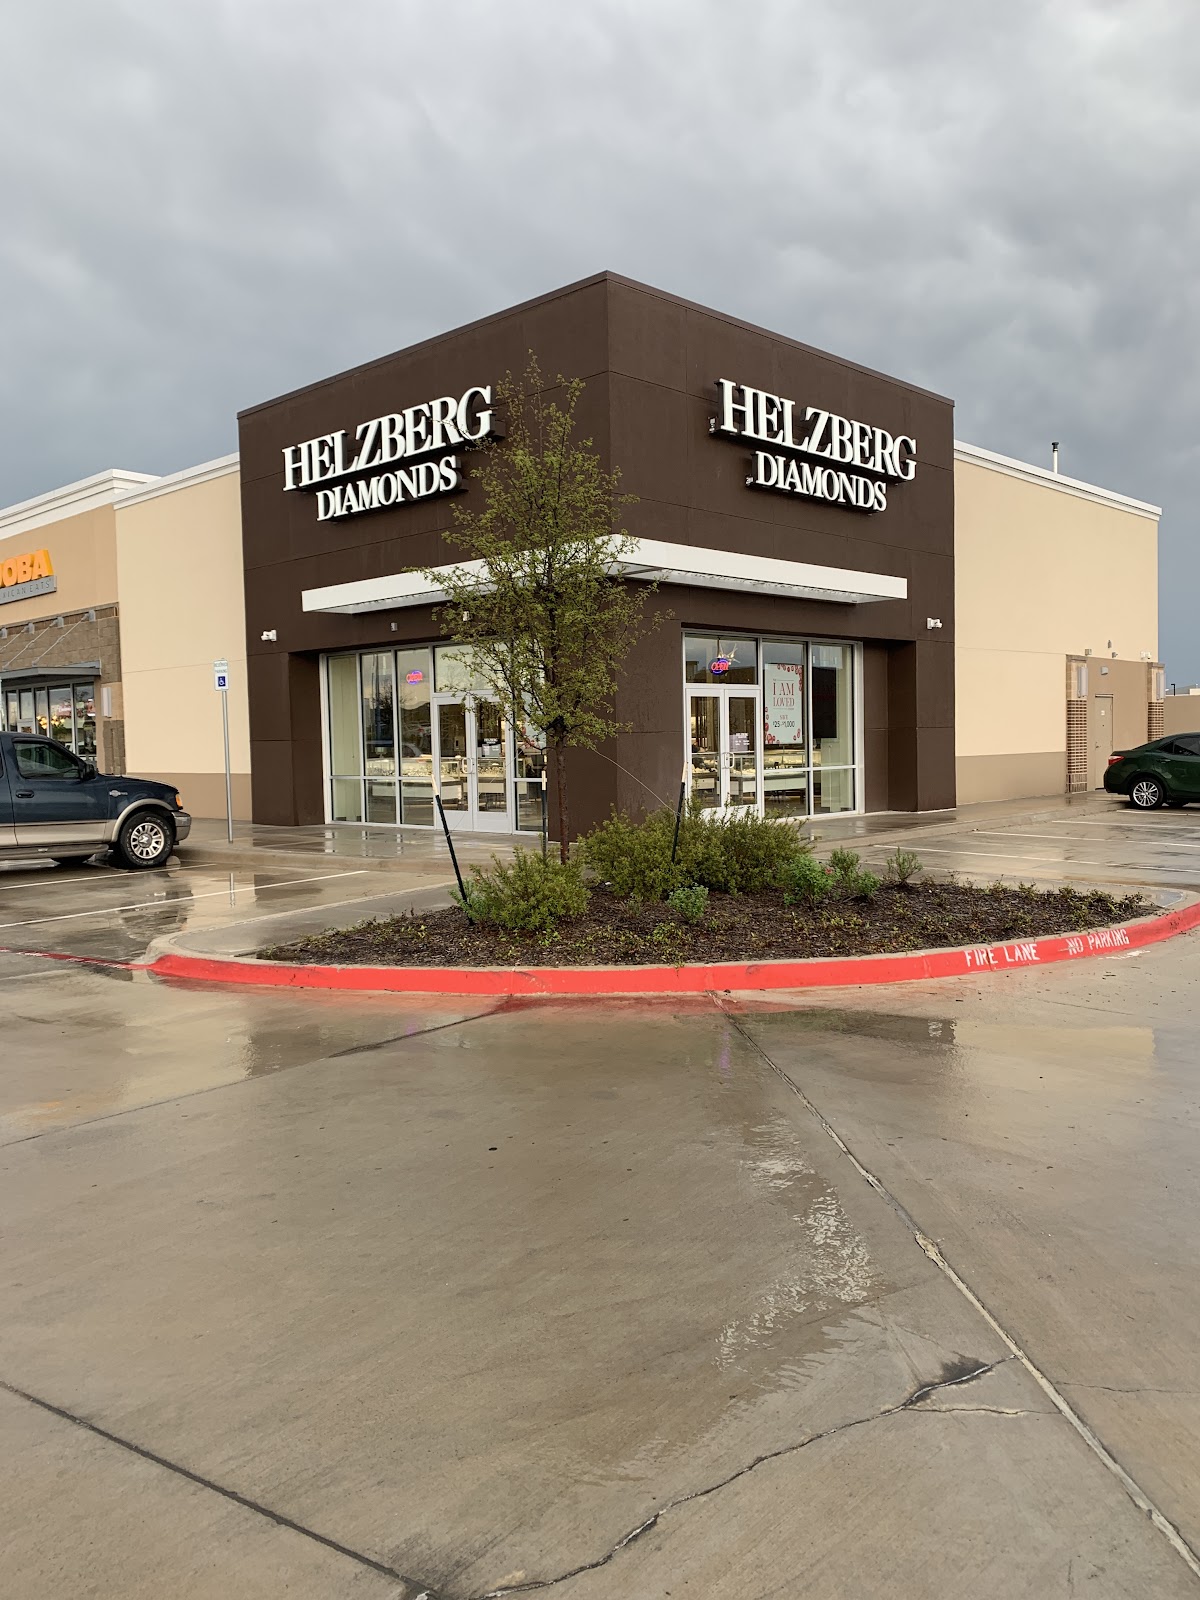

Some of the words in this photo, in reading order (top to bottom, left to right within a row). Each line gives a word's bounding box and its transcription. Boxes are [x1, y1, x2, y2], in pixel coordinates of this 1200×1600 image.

[282, 385, 493, 491] HELZBERG
[718, 378, 917, 480] HELZBERG
[316, 455, 460, 521] DIAMONDS
[755, 450, 887, 512] DIAMONDS
[0, 549, 53, 588] OBA
[779, 682, 795, 695] AM
[964, 948, 999, 967] FIRE
[1003, 943, 1041, 962] LANE
[1066, 936, 1084, 955] NO
[1087, 928, 1130, 950] PARKING
